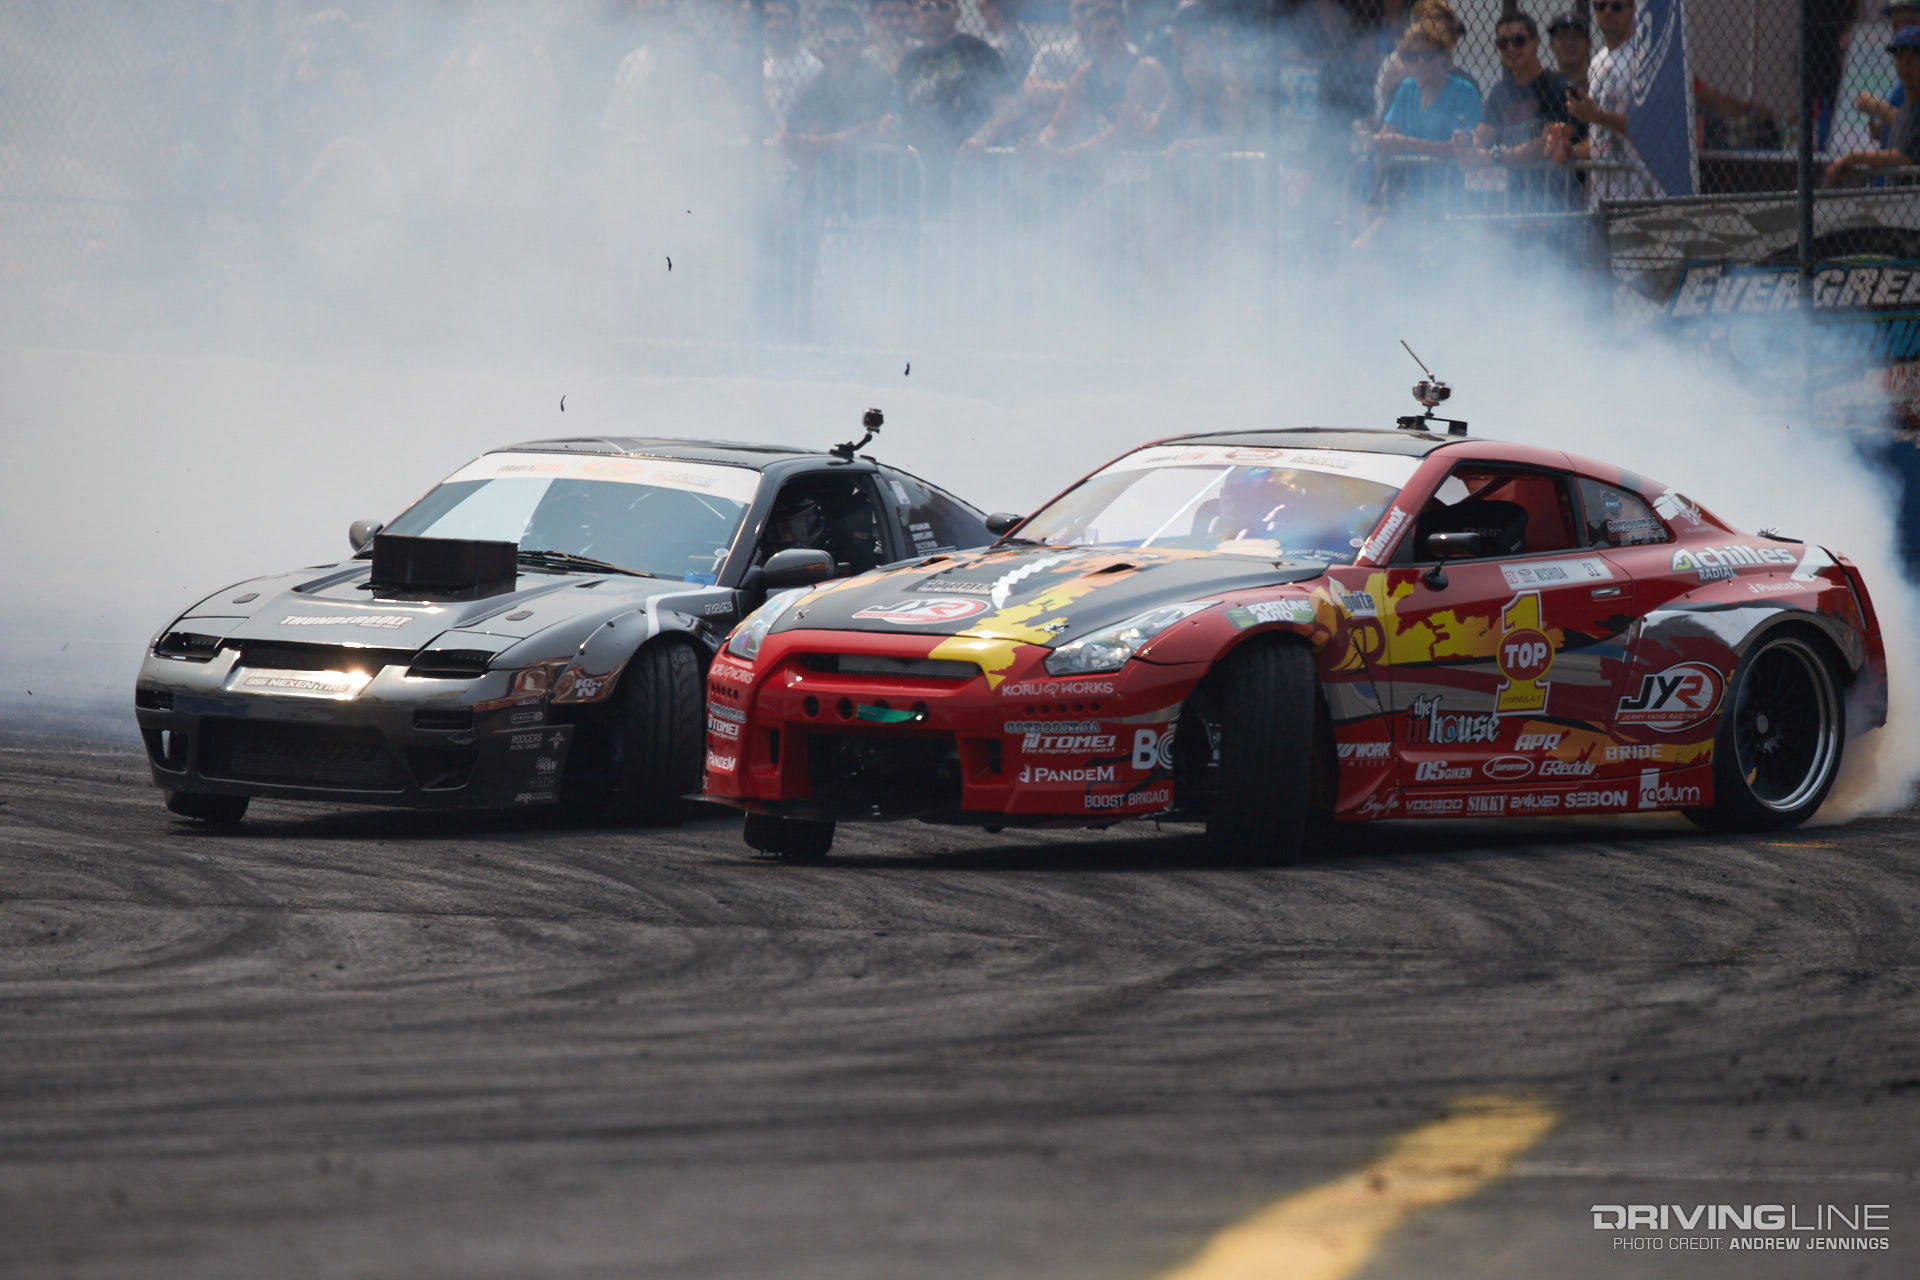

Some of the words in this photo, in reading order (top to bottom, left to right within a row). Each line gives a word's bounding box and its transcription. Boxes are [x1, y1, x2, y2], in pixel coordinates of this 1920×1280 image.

[1672, 545, 1798, 572] Achilles
[1699, 567, 1738, 581] RADIAL
[1247, 600, 1311, 615] FORTUNE
[1341, 590, 1375, 612] ignite
[279, 615, 416, 627] THUNDERBOLT
[1257, 611, 1295, 623] AUTO
[1504, 642, 1547, 669] TOP
[269, 678, 315, 689] NEXEN
[1002, 683, 1042, 697] KORU
[1061, 681, 1114, 695] WORKS
[1620, 675, 1704, 710] JYR
[1414, 694, 1432, 719] the
[1041, 734, 1117, 749] TOMEI
[1514, 733, 1562, 751] APR
[1354, 742, 1392, 758] WORK
[1604, 744, 1664, 761] BRIDE
[1415, 761, 1448, 781] OS
[1444, 767, 1472, 780] GIKEN
[1537, 760, 1597, 776] GReddy
[1084, 794, 1125, 809] BOOST
[1467, 795, 1508, 812] SIKKY
[1564, 790, 1628, 808] SEBON
